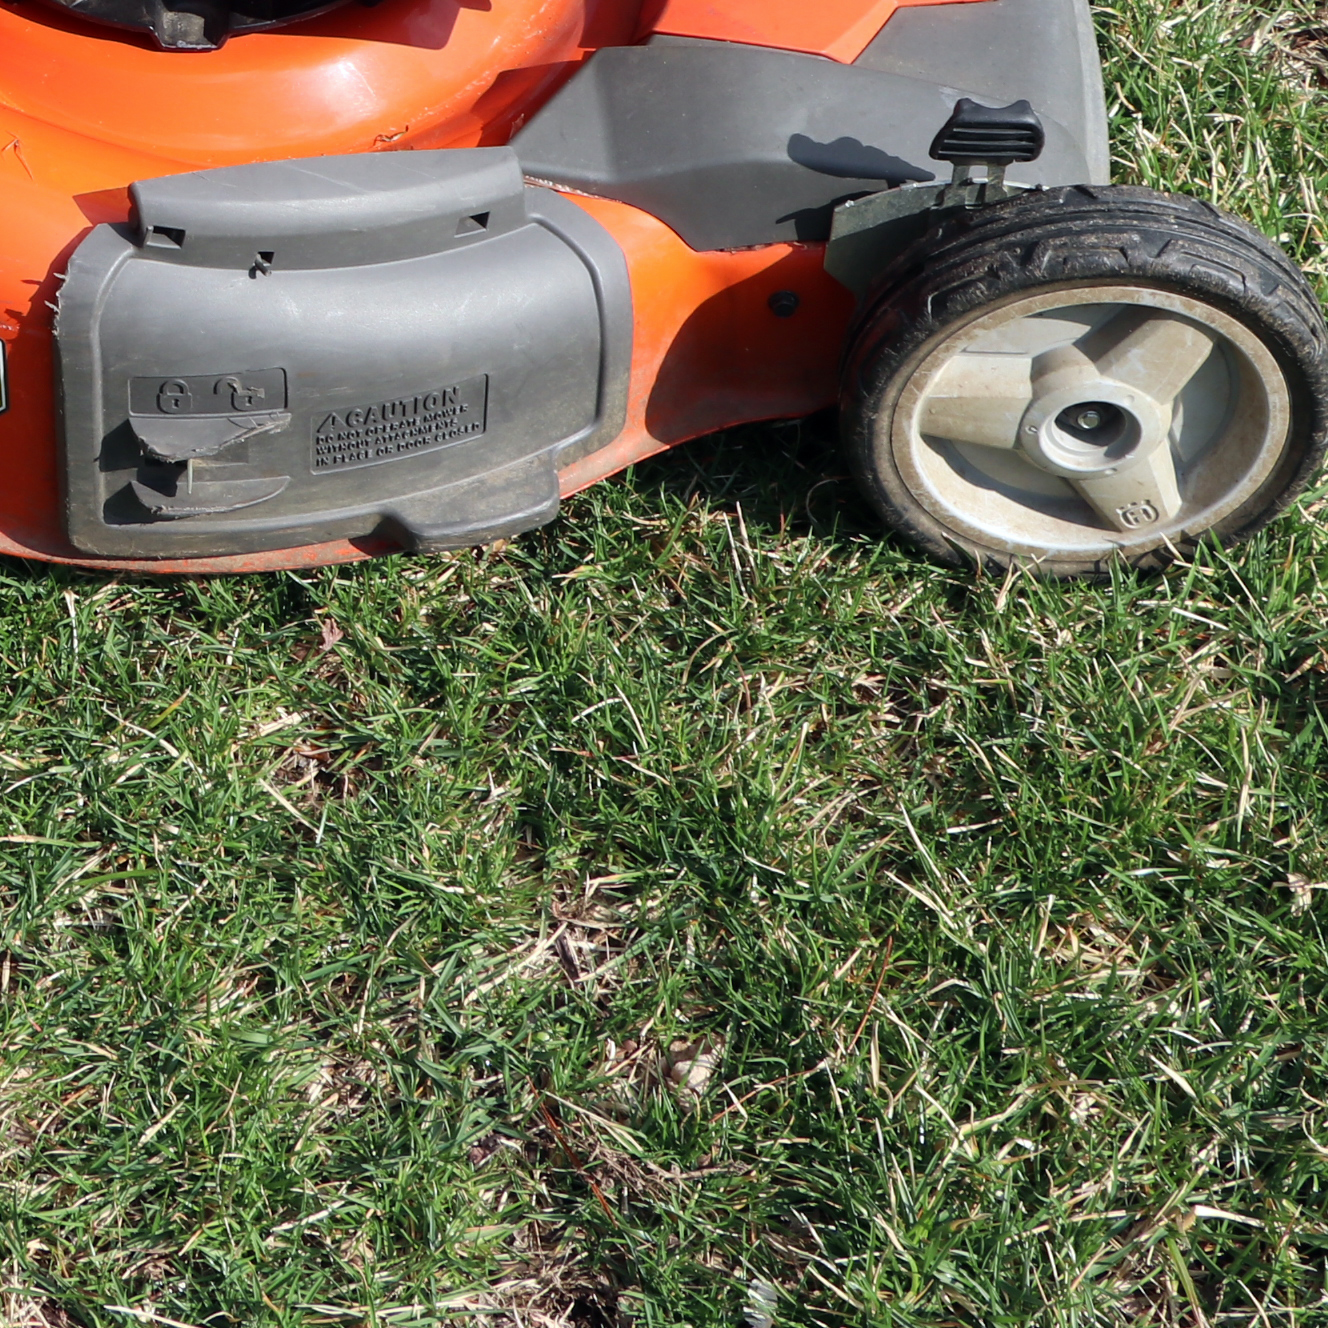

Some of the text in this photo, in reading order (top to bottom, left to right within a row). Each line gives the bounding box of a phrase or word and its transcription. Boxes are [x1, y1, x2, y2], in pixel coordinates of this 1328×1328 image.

[316, 404, 469, 445] DO NOT OPERATE MOWER
[346, 385, 460, 428] CAUTION
[316, 417, 459, 455] WITHOUT ATTACHMENTS
[316, 422, 481, 466] IN PLACE OR DOOR CLOSED
